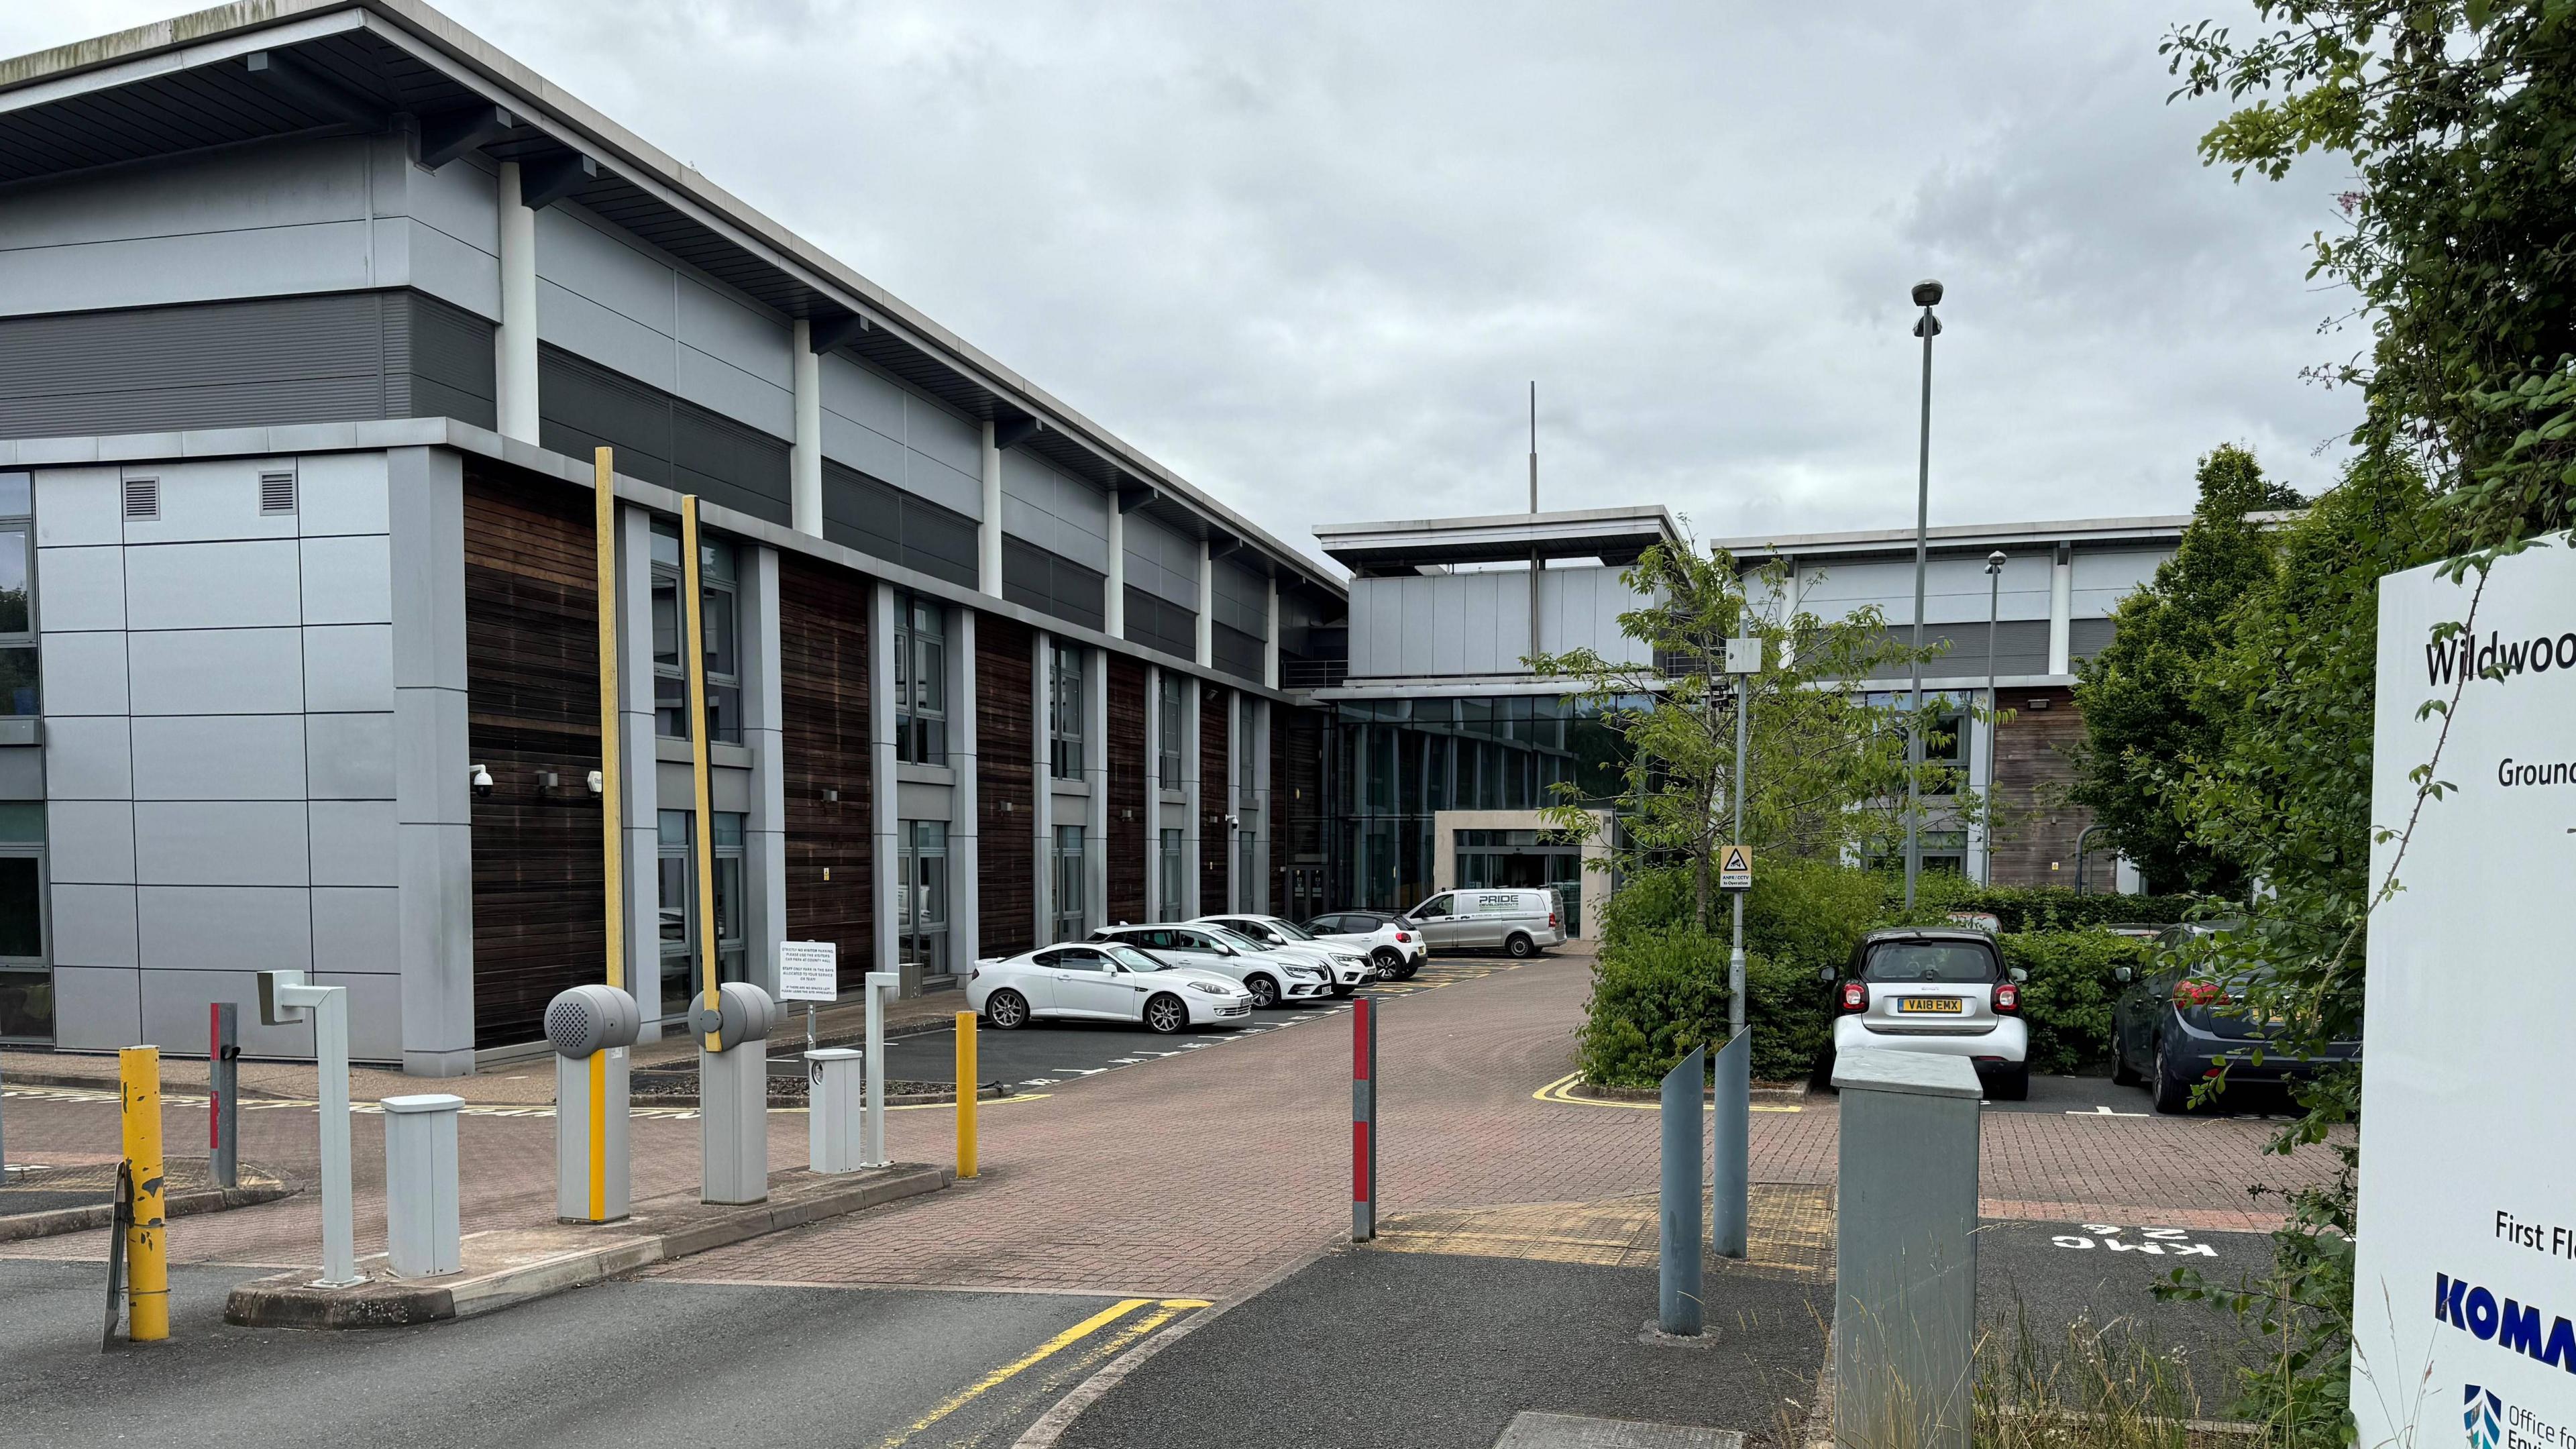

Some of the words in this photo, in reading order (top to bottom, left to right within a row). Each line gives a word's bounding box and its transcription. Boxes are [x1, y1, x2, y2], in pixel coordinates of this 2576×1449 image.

[1479, 895, 1519, 903] PRIDE
[1909, 1000, 1933, 1009] VA18
[1937, 1001, 1957, 1010] EMX
[2496, 1210, 2544, 1252] First
[2553, 1226, 2576, 1260] Fl
[2051, 1236, 2218, 1256] KMC
[2509, 1405, 2555, 1443] Office
